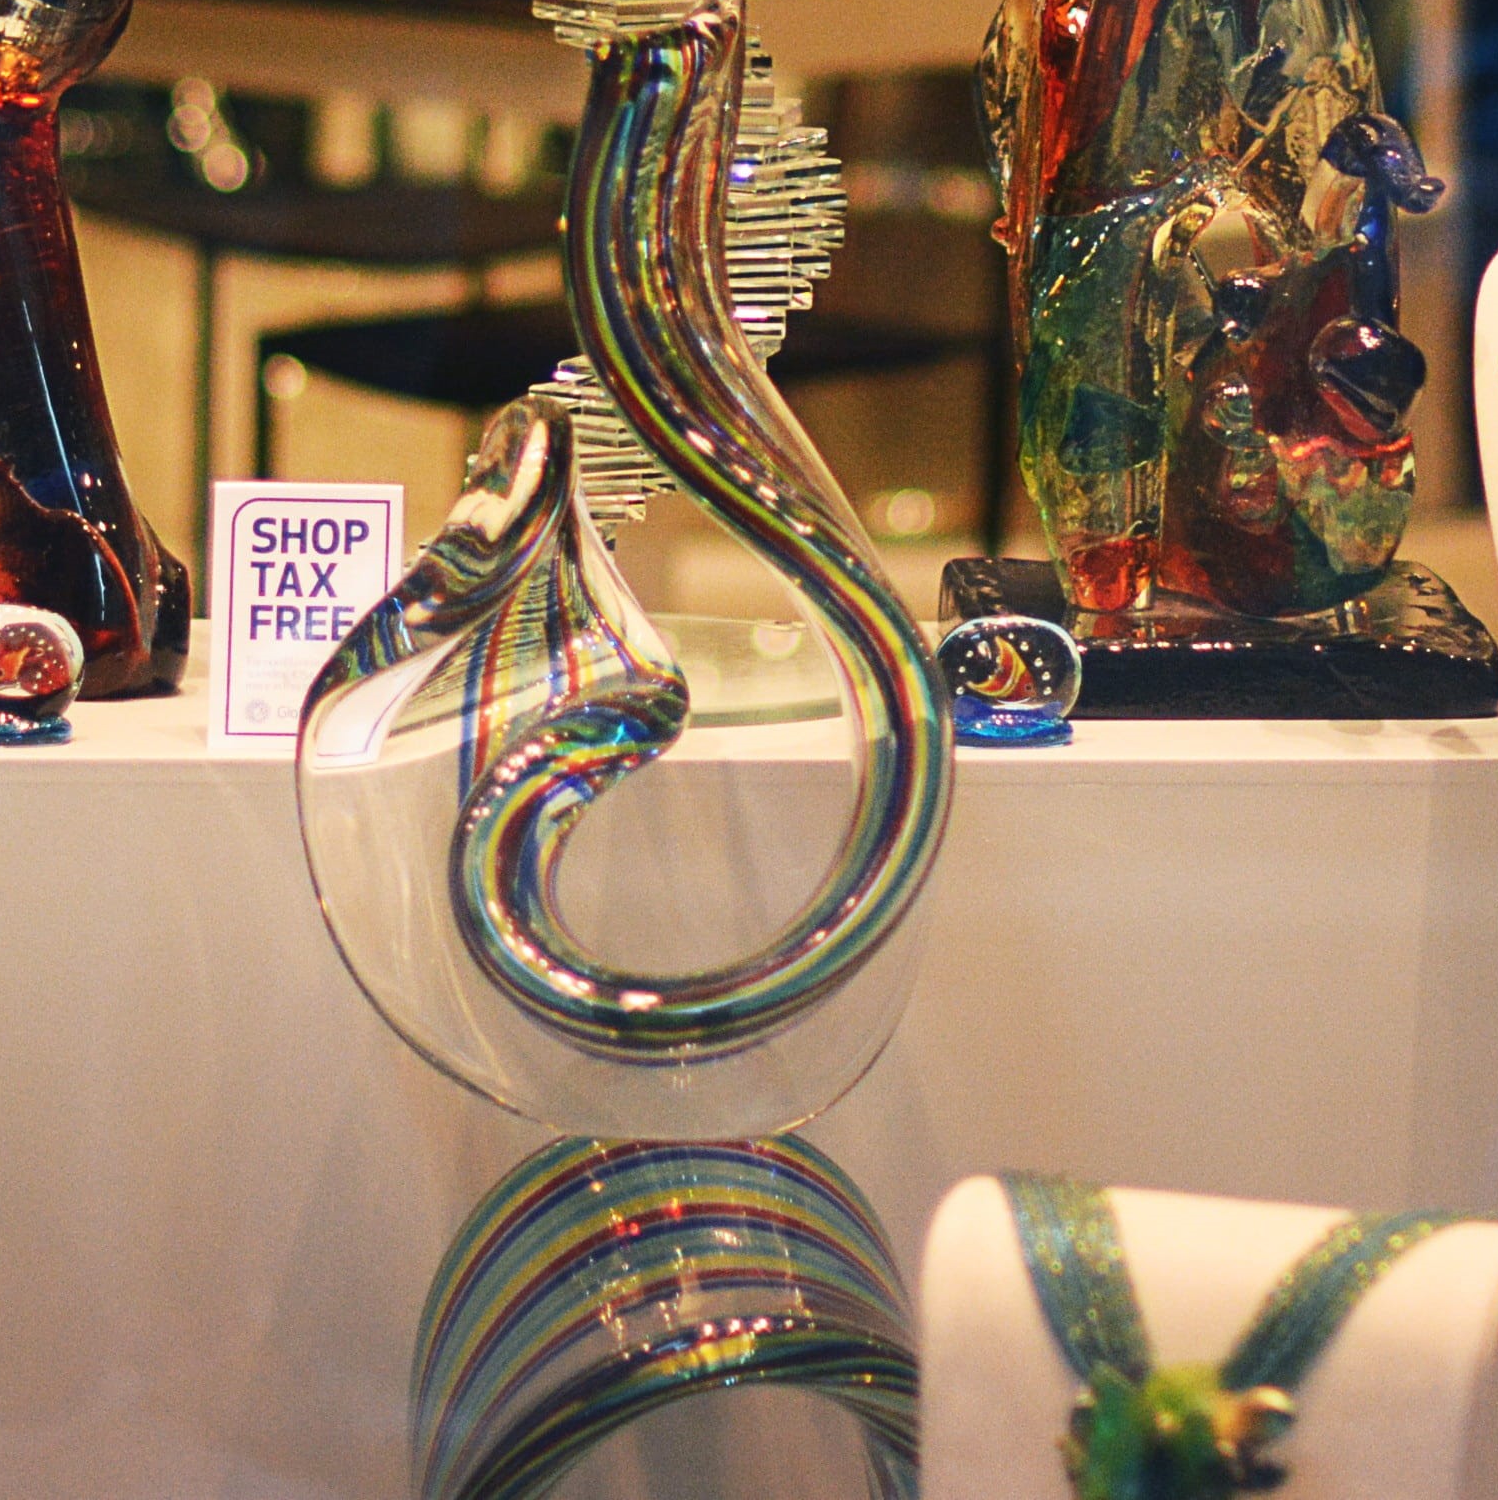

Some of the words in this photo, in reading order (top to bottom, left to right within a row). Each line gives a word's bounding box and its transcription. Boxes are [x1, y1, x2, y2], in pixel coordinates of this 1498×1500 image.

[251, 517, 370, 555] SHOP
[250, 561, 338, 598] TAX
[249, 604, 356, 642] FREE
